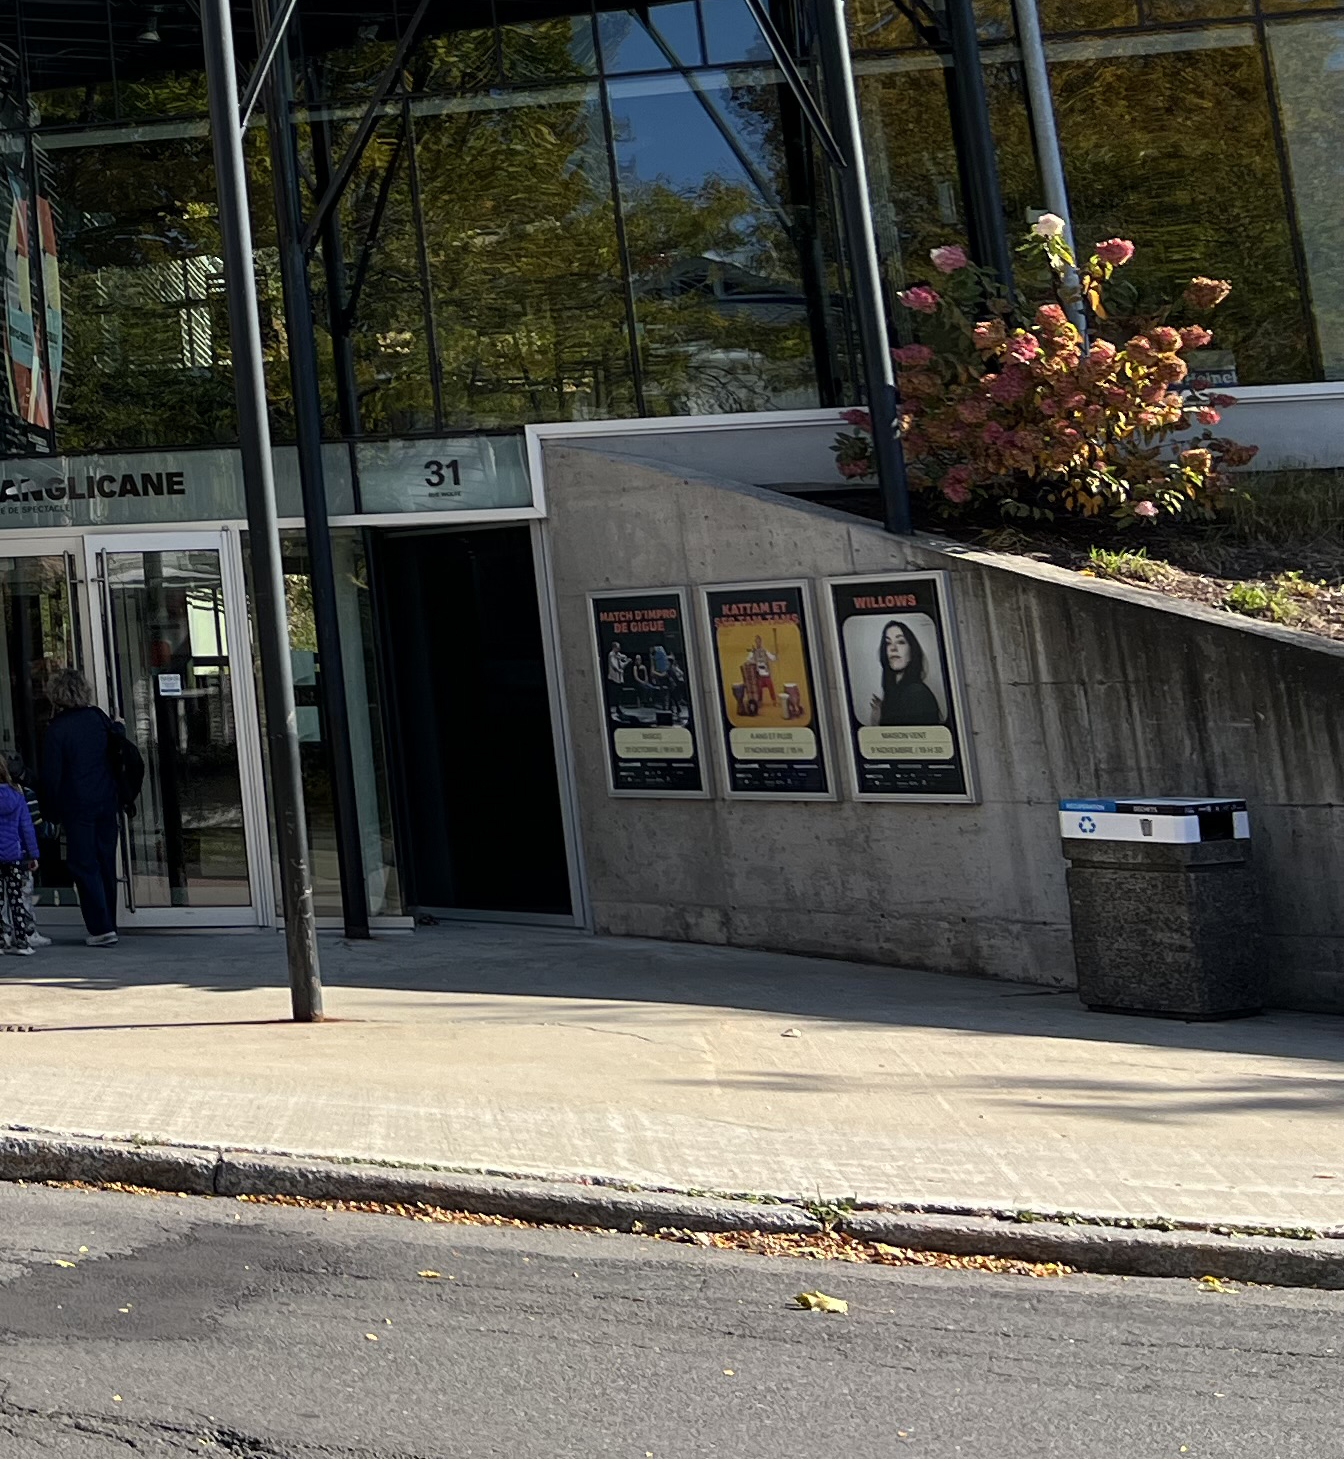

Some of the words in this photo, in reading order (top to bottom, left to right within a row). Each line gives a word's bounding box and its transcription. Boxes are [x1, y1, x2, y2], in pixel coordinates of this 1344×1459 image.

[423, 459, 461, 487] 31
[8, 506, 19, 514] DE
[21, 504, 71, 514] SPECTACLE
[722, 603, 770, 615] KATTAM
[772, 601, 787, 613] ET
[853, 594, 917, 609] WILLOWS
[599, 611, 633, 622] MATCH
[635, 608, 677, 620] D'IMPRO
[614, 622, 629, 633] DE
[630, 620, 665, 632] GIGUE
